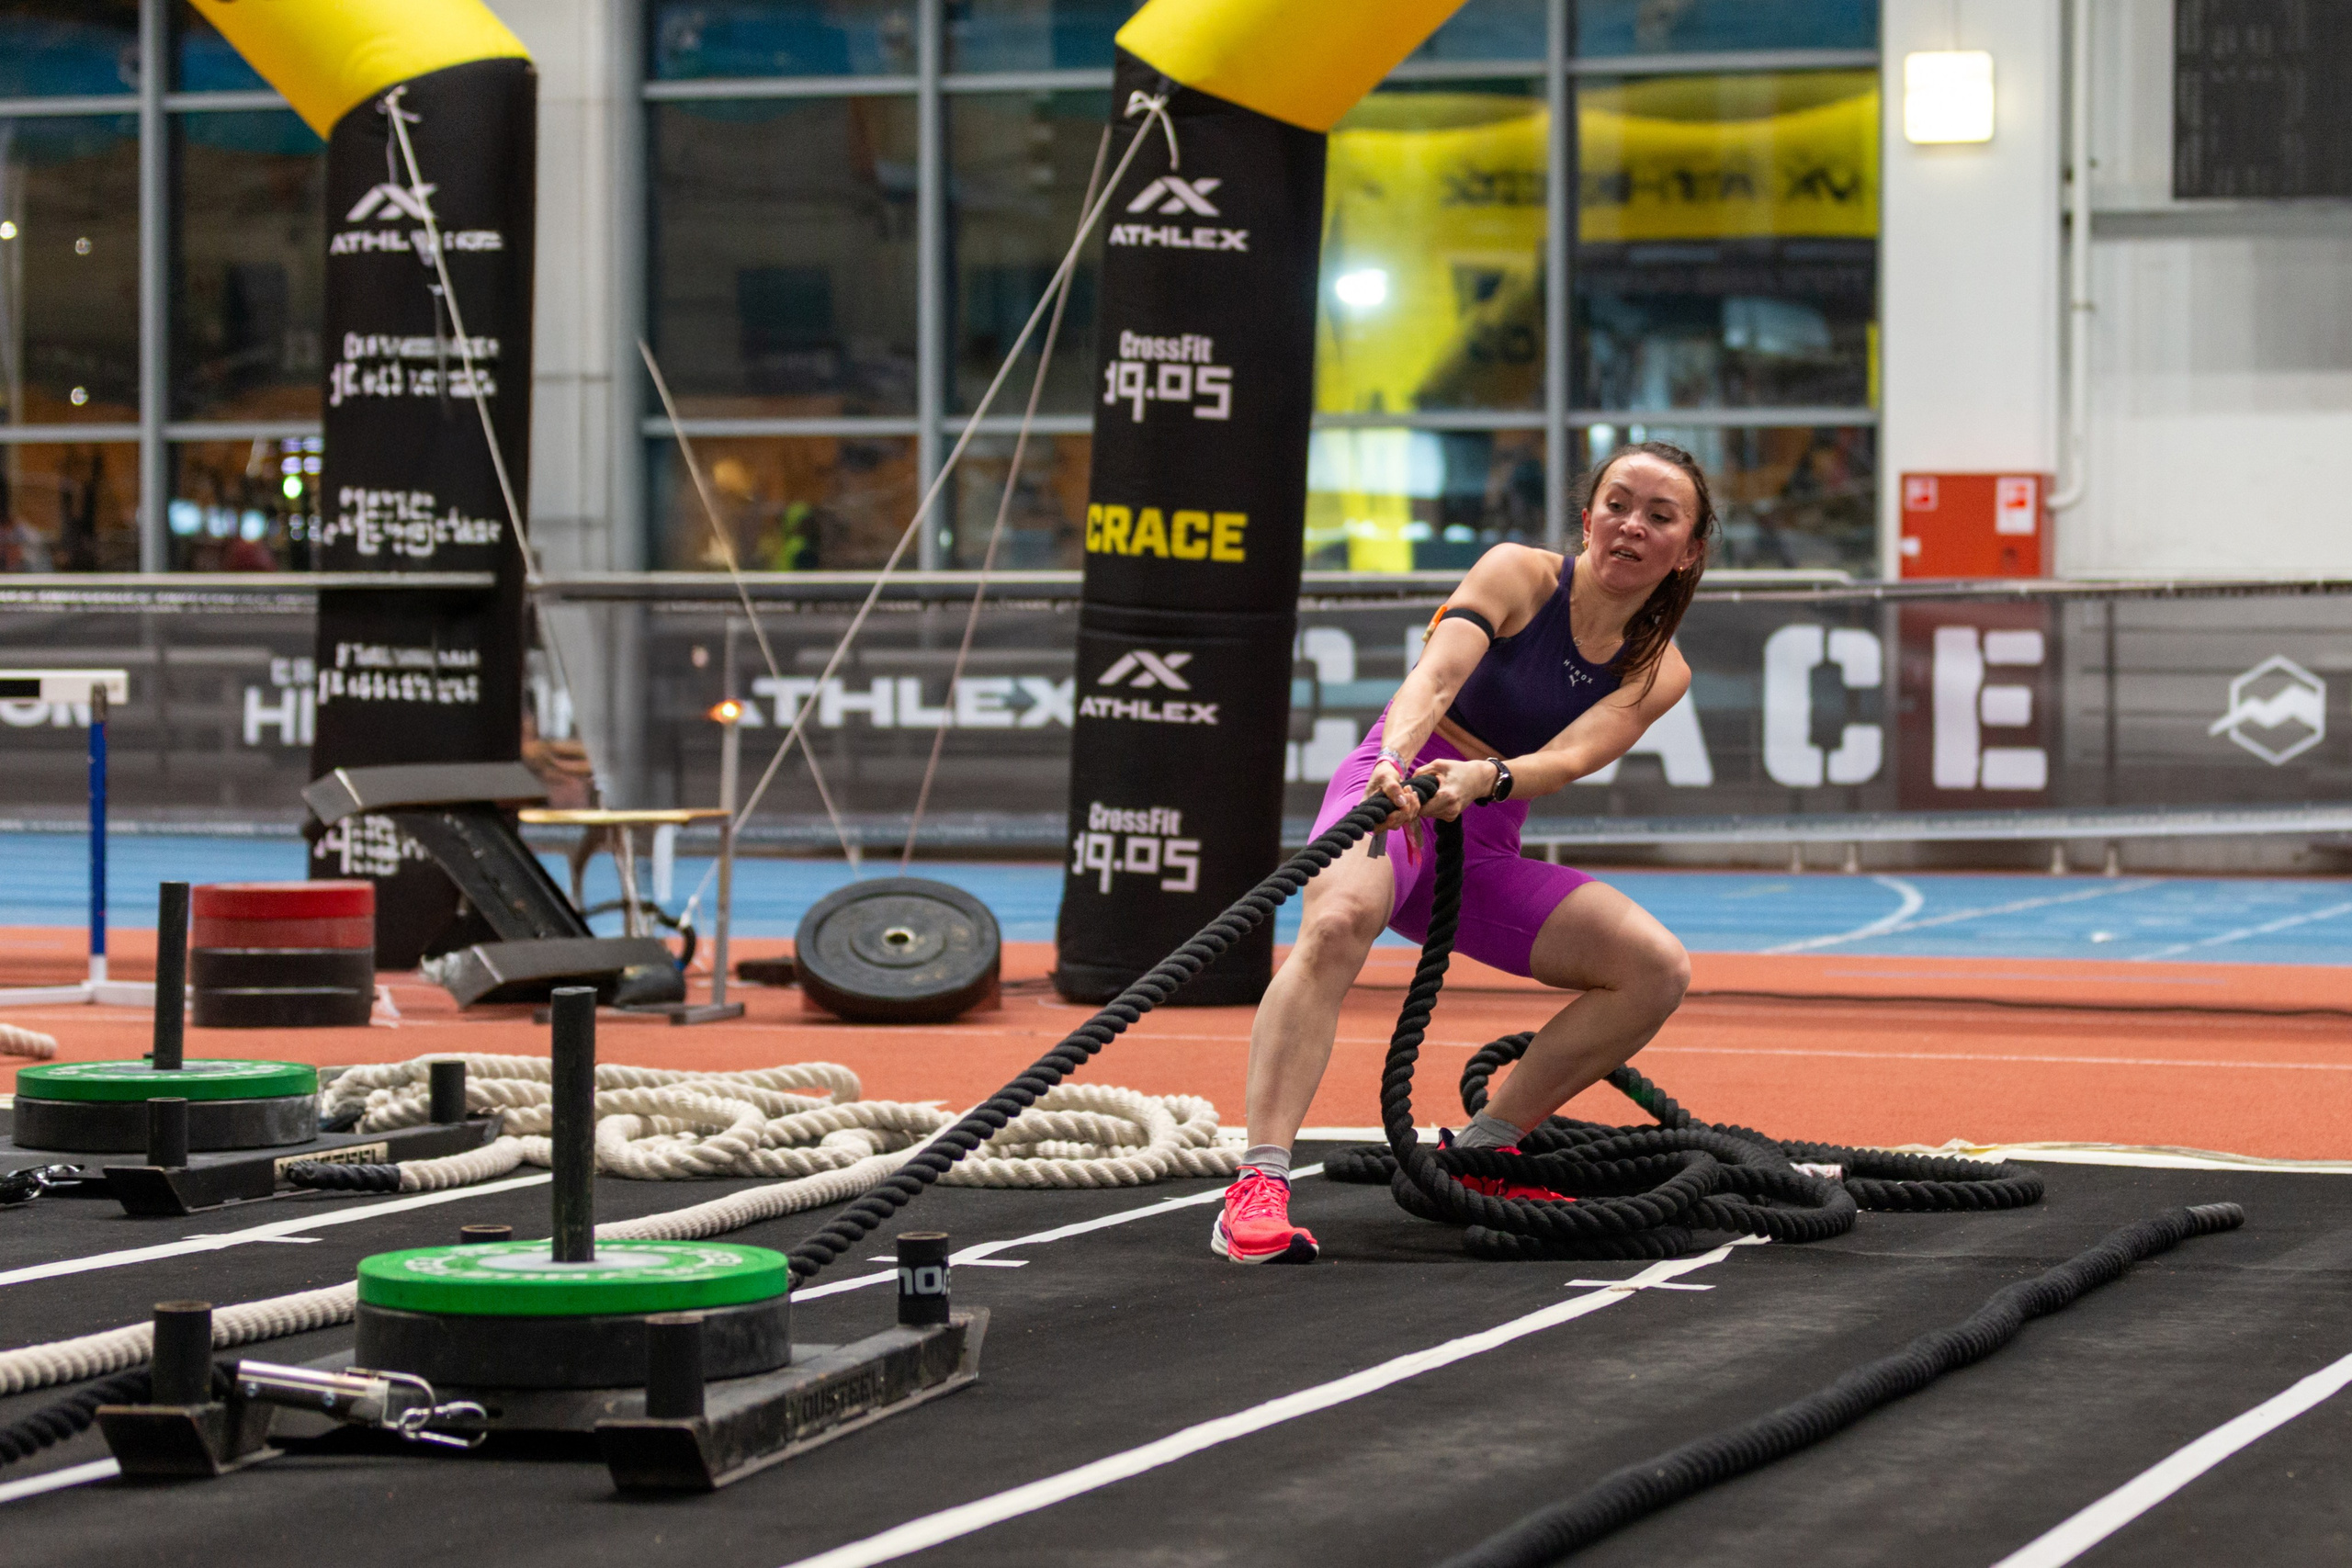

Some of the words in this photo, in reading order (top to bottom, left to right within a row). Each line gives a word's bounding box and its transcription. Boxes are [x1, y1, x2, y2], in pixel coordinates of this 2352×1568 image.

[1108, 224, 1250, 252] ATHLEX
[1119, 330, 1214, 364] CrossFit
[1563, 659, 1594, 685] HYROX
[1079, 695, 1219, 726] ATHLEX
[1089, 801, 1182, 837] CrossFit
